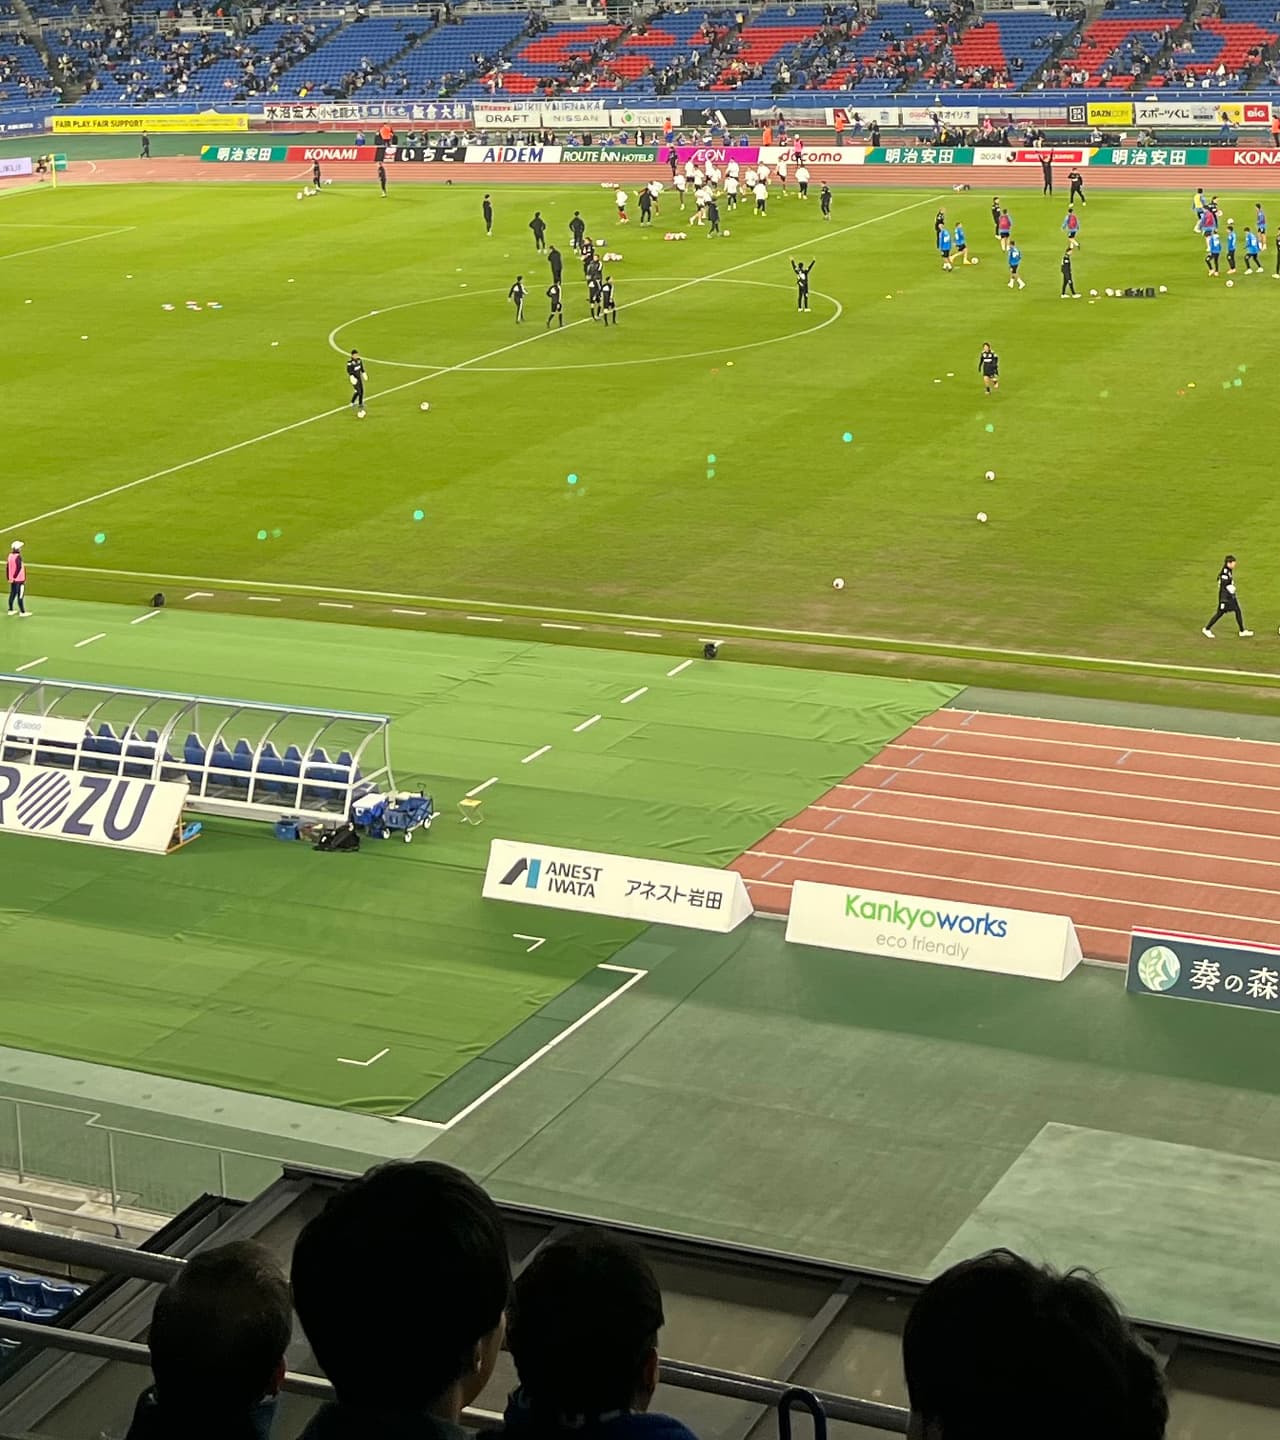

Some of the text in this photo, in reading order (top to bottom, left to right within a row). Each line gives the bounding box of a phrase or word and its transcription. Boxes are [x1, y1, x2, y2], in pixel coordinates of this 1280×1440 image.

[266, 106, 317, 120] 水沼宏太
[486, 114, 529, 123] DRAFT
[553, 114, 599, 122] NISSAN
[1139, 108, 1189, 119] スポーツくじ
[55, 120, 70, 129] FAIR
[93, 120, 109, 128] FAIR
[110, 119, 143, 128] SUPPORT
[217, 147, 271, 161] 明治安田
[303, 148, 358, 160] KONAMI
[401, 146, 458, 161] いちご
[563, 150, 600, 161] ROUTE
[622, 153, 654, 162] HOTELS
[781, 148, 843, 162] dcomo
[885, 148, 954, 164] 明治安田
[981, 153, 1002, 161] 2024
[1112, 149, 1187, 165] 明治安田
[545, 861, 603, 882] ANEST
[548, 877, 596, 899] IWATA
[624, 879, 723, 910] アネスト岩田
[845, 894, 1008, 938] Kankyoworks
[876, 933, 969, 960] eco friendly
[1189, 959, 1280, 1000] 奏の森
